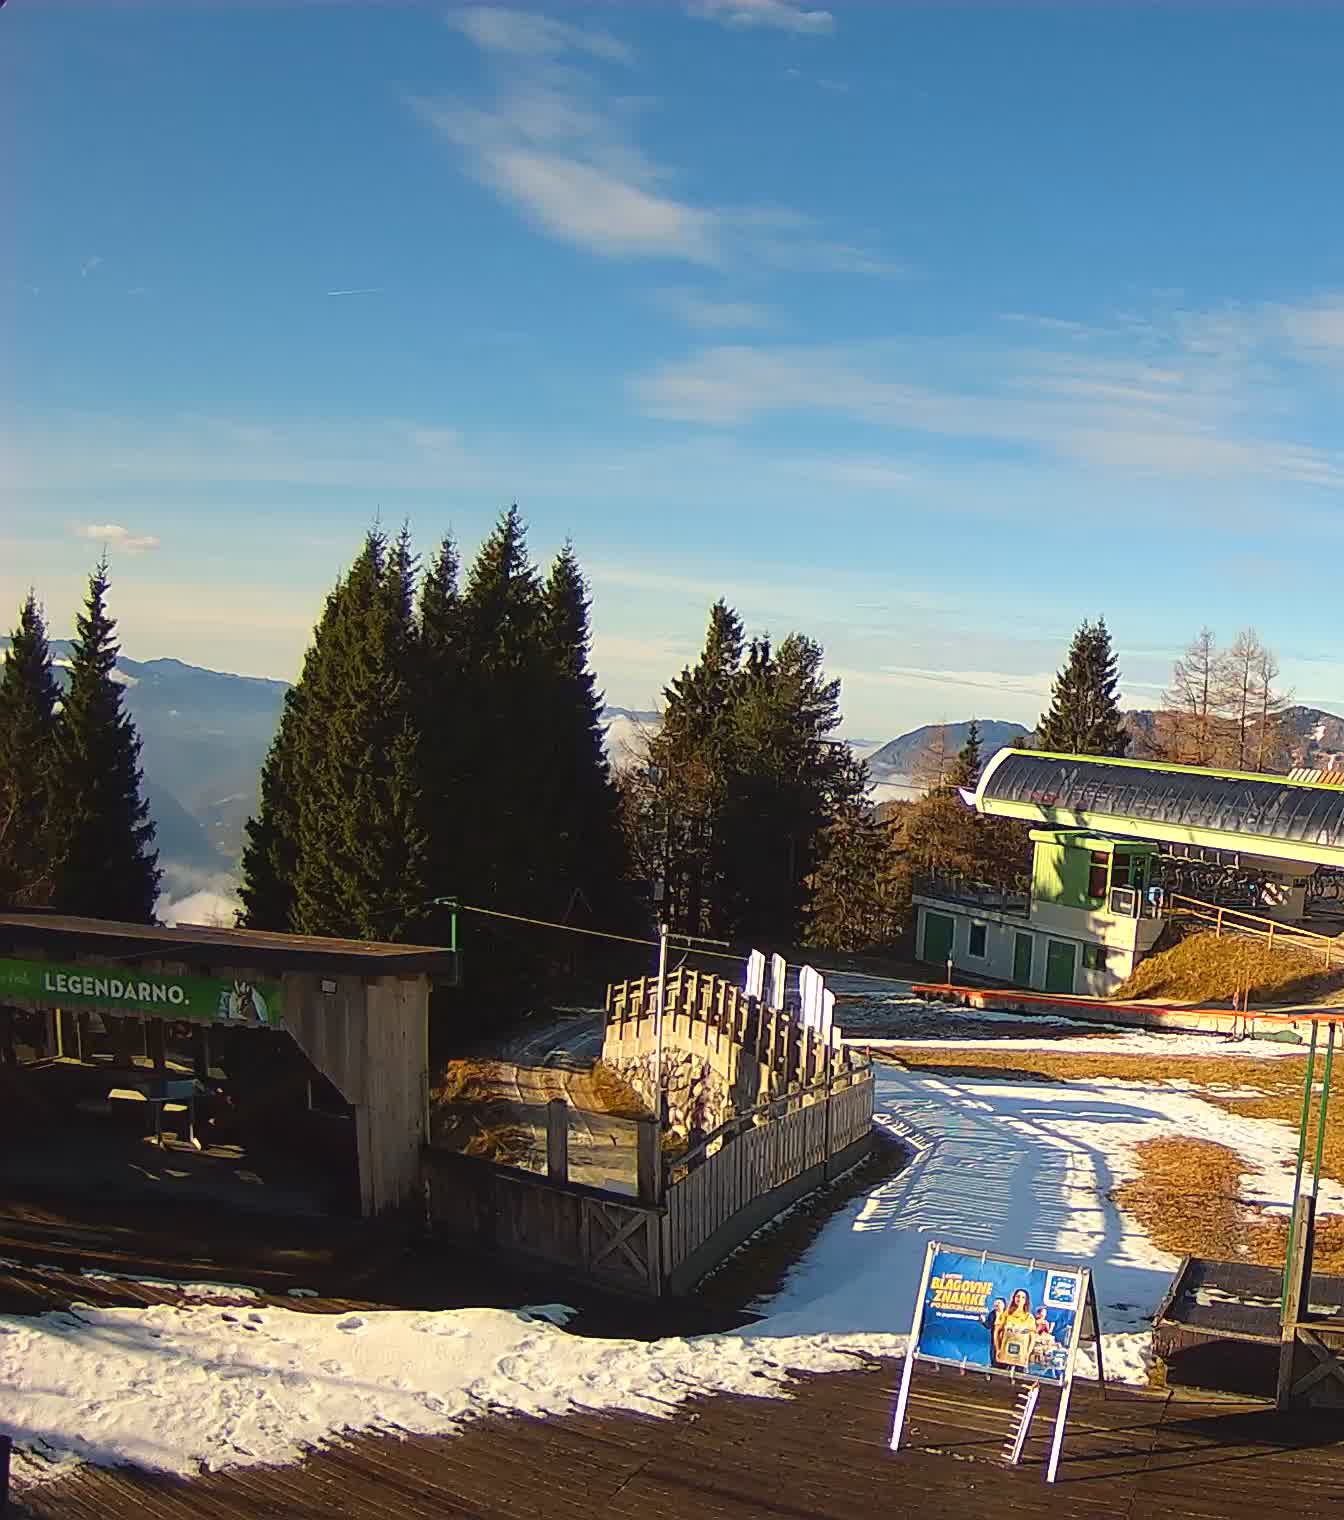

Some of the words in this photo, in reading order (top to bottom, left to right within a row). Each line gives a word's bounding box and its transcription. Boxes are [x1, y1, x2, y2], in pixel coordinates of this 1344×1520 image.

[44, 972, 190, 1005] LEGENDARNO.
[930, 1277, 993, 1296] BLAGOVNE
[933, 1289, 987, 1306] ZNAMKE
